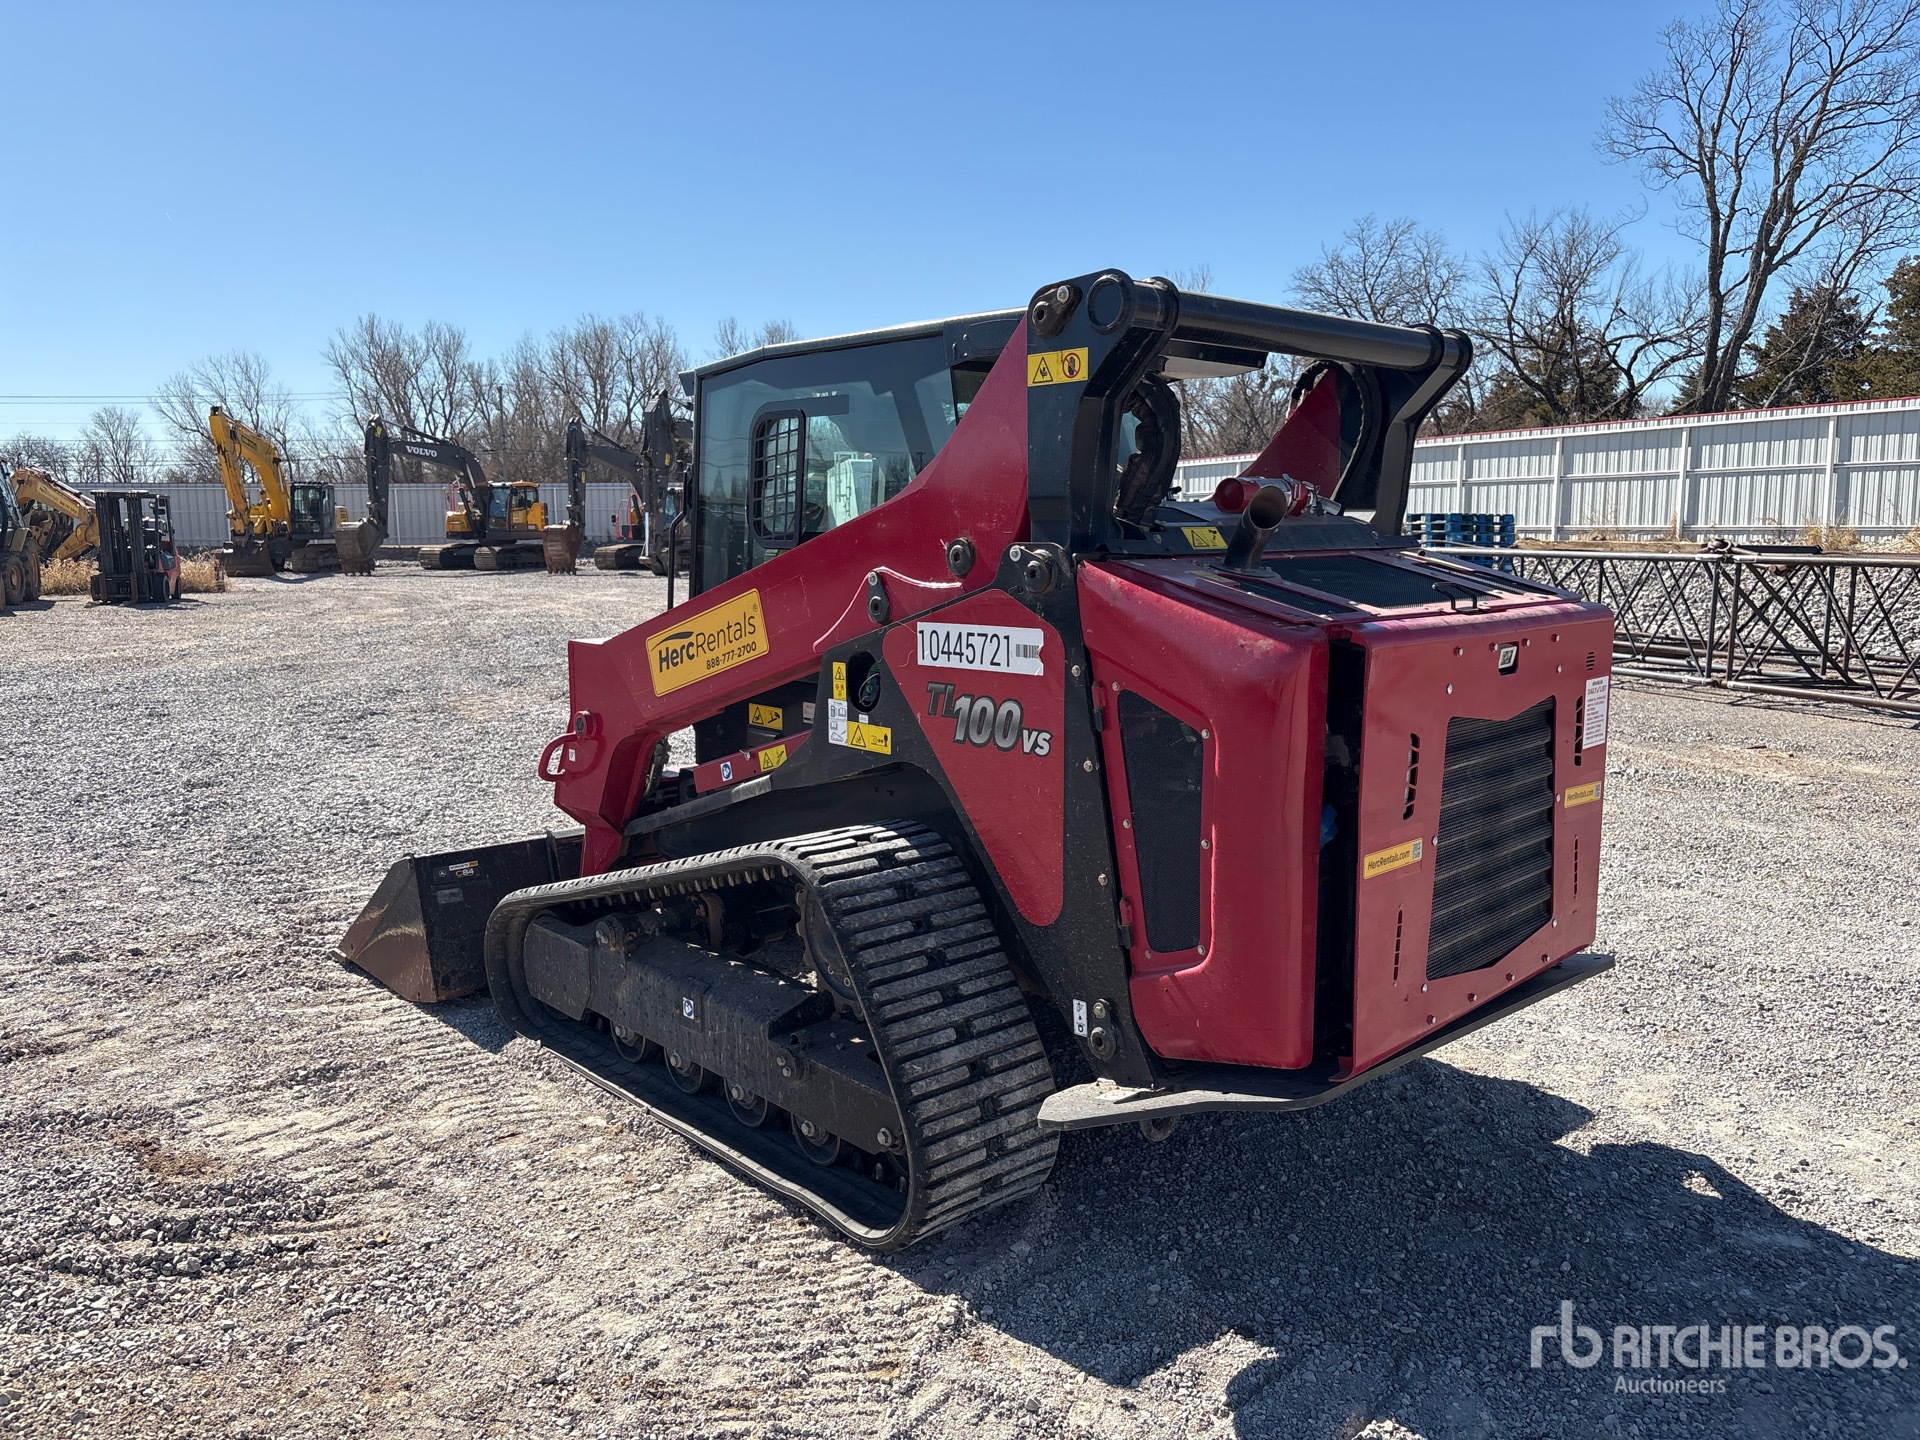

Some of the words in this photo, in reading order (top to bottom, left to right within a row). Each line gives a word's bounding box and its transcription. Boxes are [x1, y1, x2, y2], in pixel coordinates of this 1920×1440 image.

[405, 445, 438, 458] VOLVO
[706, 641, 757, 670] 888-777-2700
[918, 629, 1011, 668] 10445721
[1367, 851, 1410, 871] HercRentals.com
